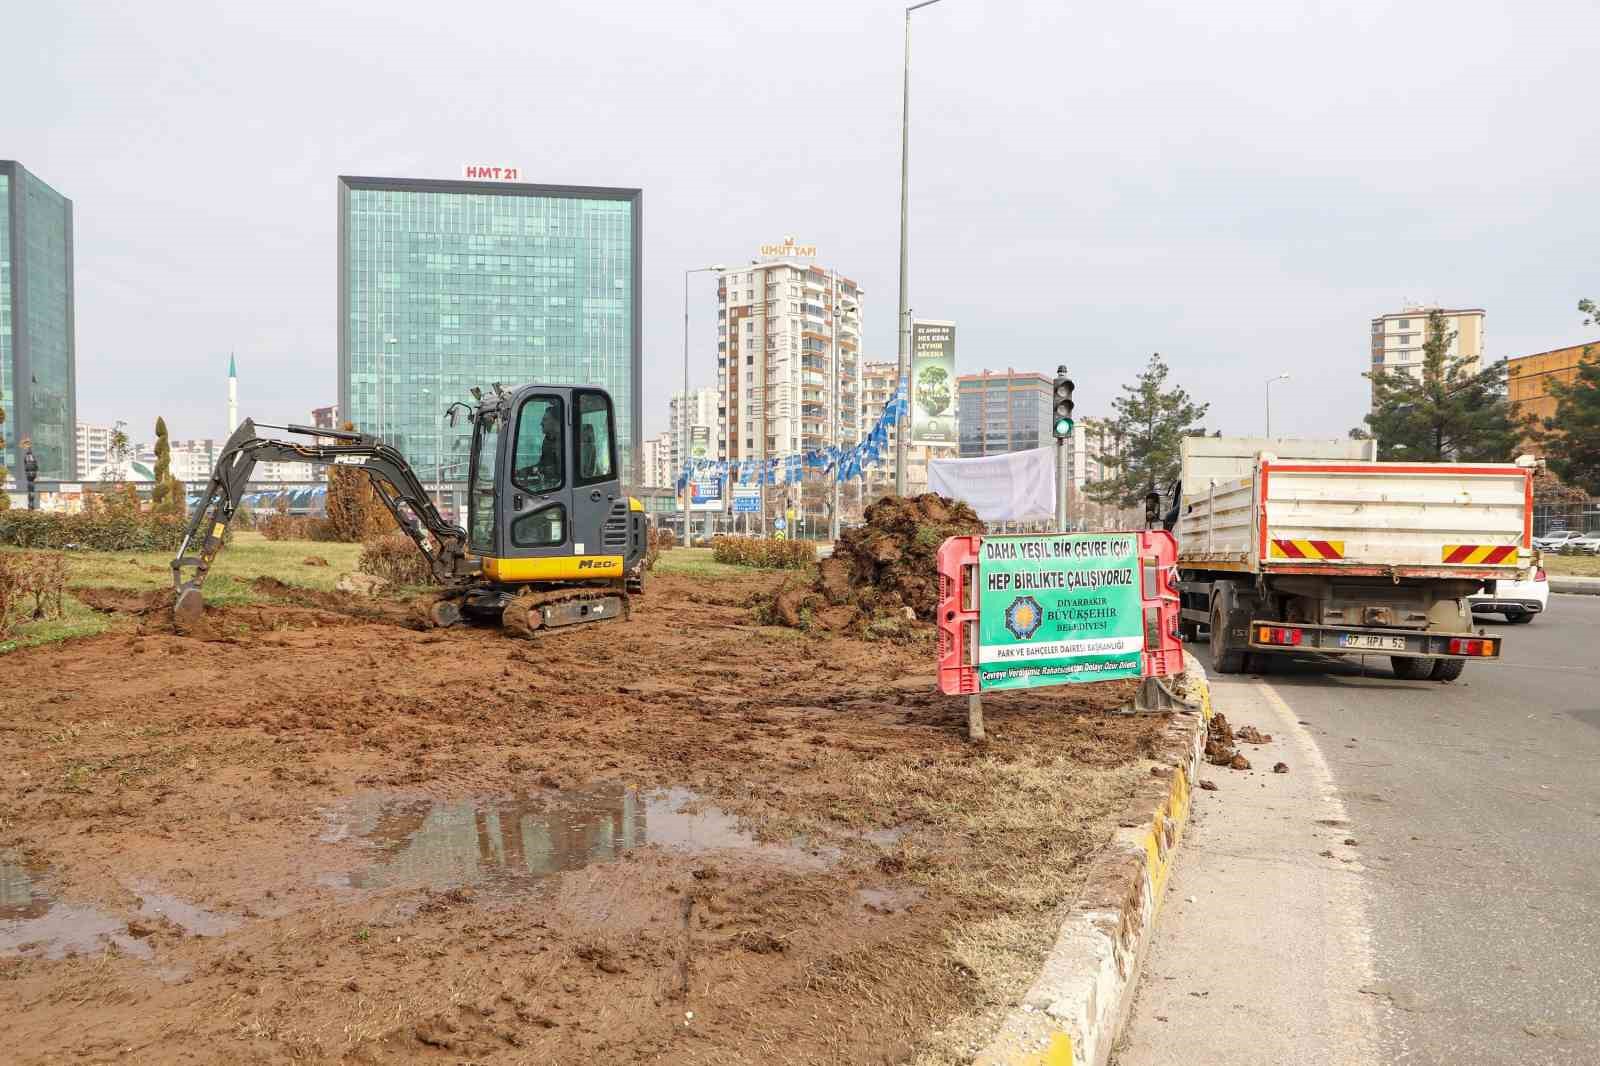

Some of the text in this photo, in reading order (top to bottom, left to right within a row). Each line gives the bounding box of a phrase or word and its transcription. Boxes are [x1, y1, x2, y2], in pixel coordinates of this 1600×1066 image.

[466, 166, 518, 180] HMT 21
[761, 244, 817, 257] UMUT YAPI
[986, 542, 1018, 560] DAHA
[1019, 538, 1052, 562] YEŞİL
[1053, 538, 1073, 558] BİR
[1074, 541, 1108, 560] ÇEVRE
[988, 568, 1132, 592] HEP BİRLİKTE ÇALIŞIYORUZ
[1047, 607, 1118, 621] BÜYÜKŞEHİR
[997, 647, 1015, 657] PARK
[1016, 647, 1025, 656] VE
